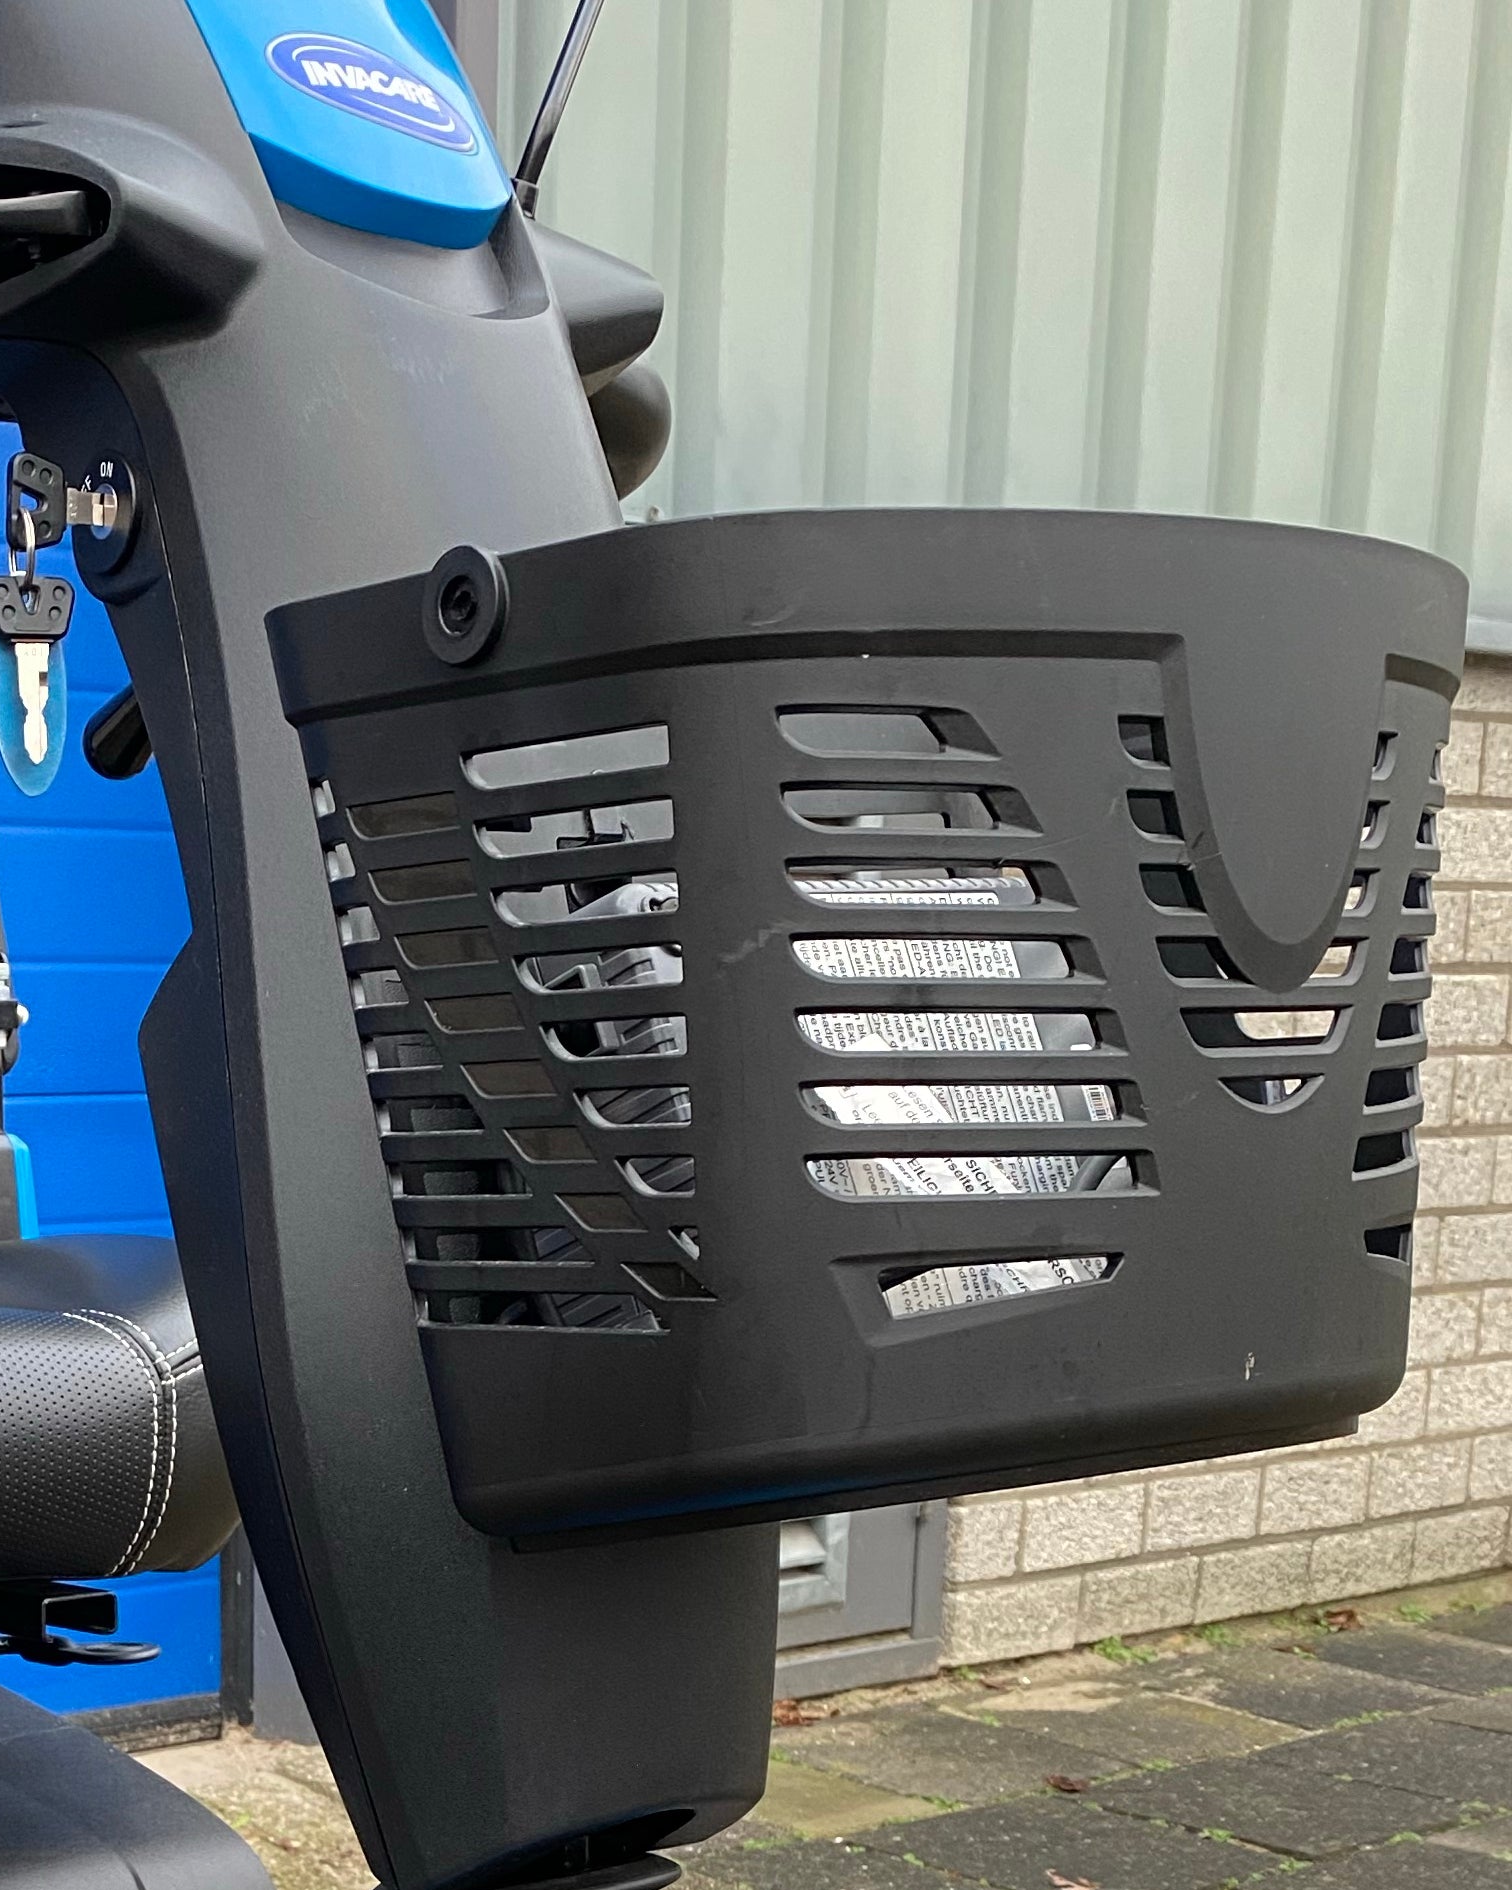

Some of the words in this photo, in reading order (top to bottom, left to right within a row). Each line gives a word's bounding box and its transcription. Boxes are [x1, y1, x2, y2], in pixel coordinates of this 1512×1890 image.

[301, 60, 440, 113] INVACARE
[100, 461, 114, 478] ON
[888, 1091, 911, 1109] auf
